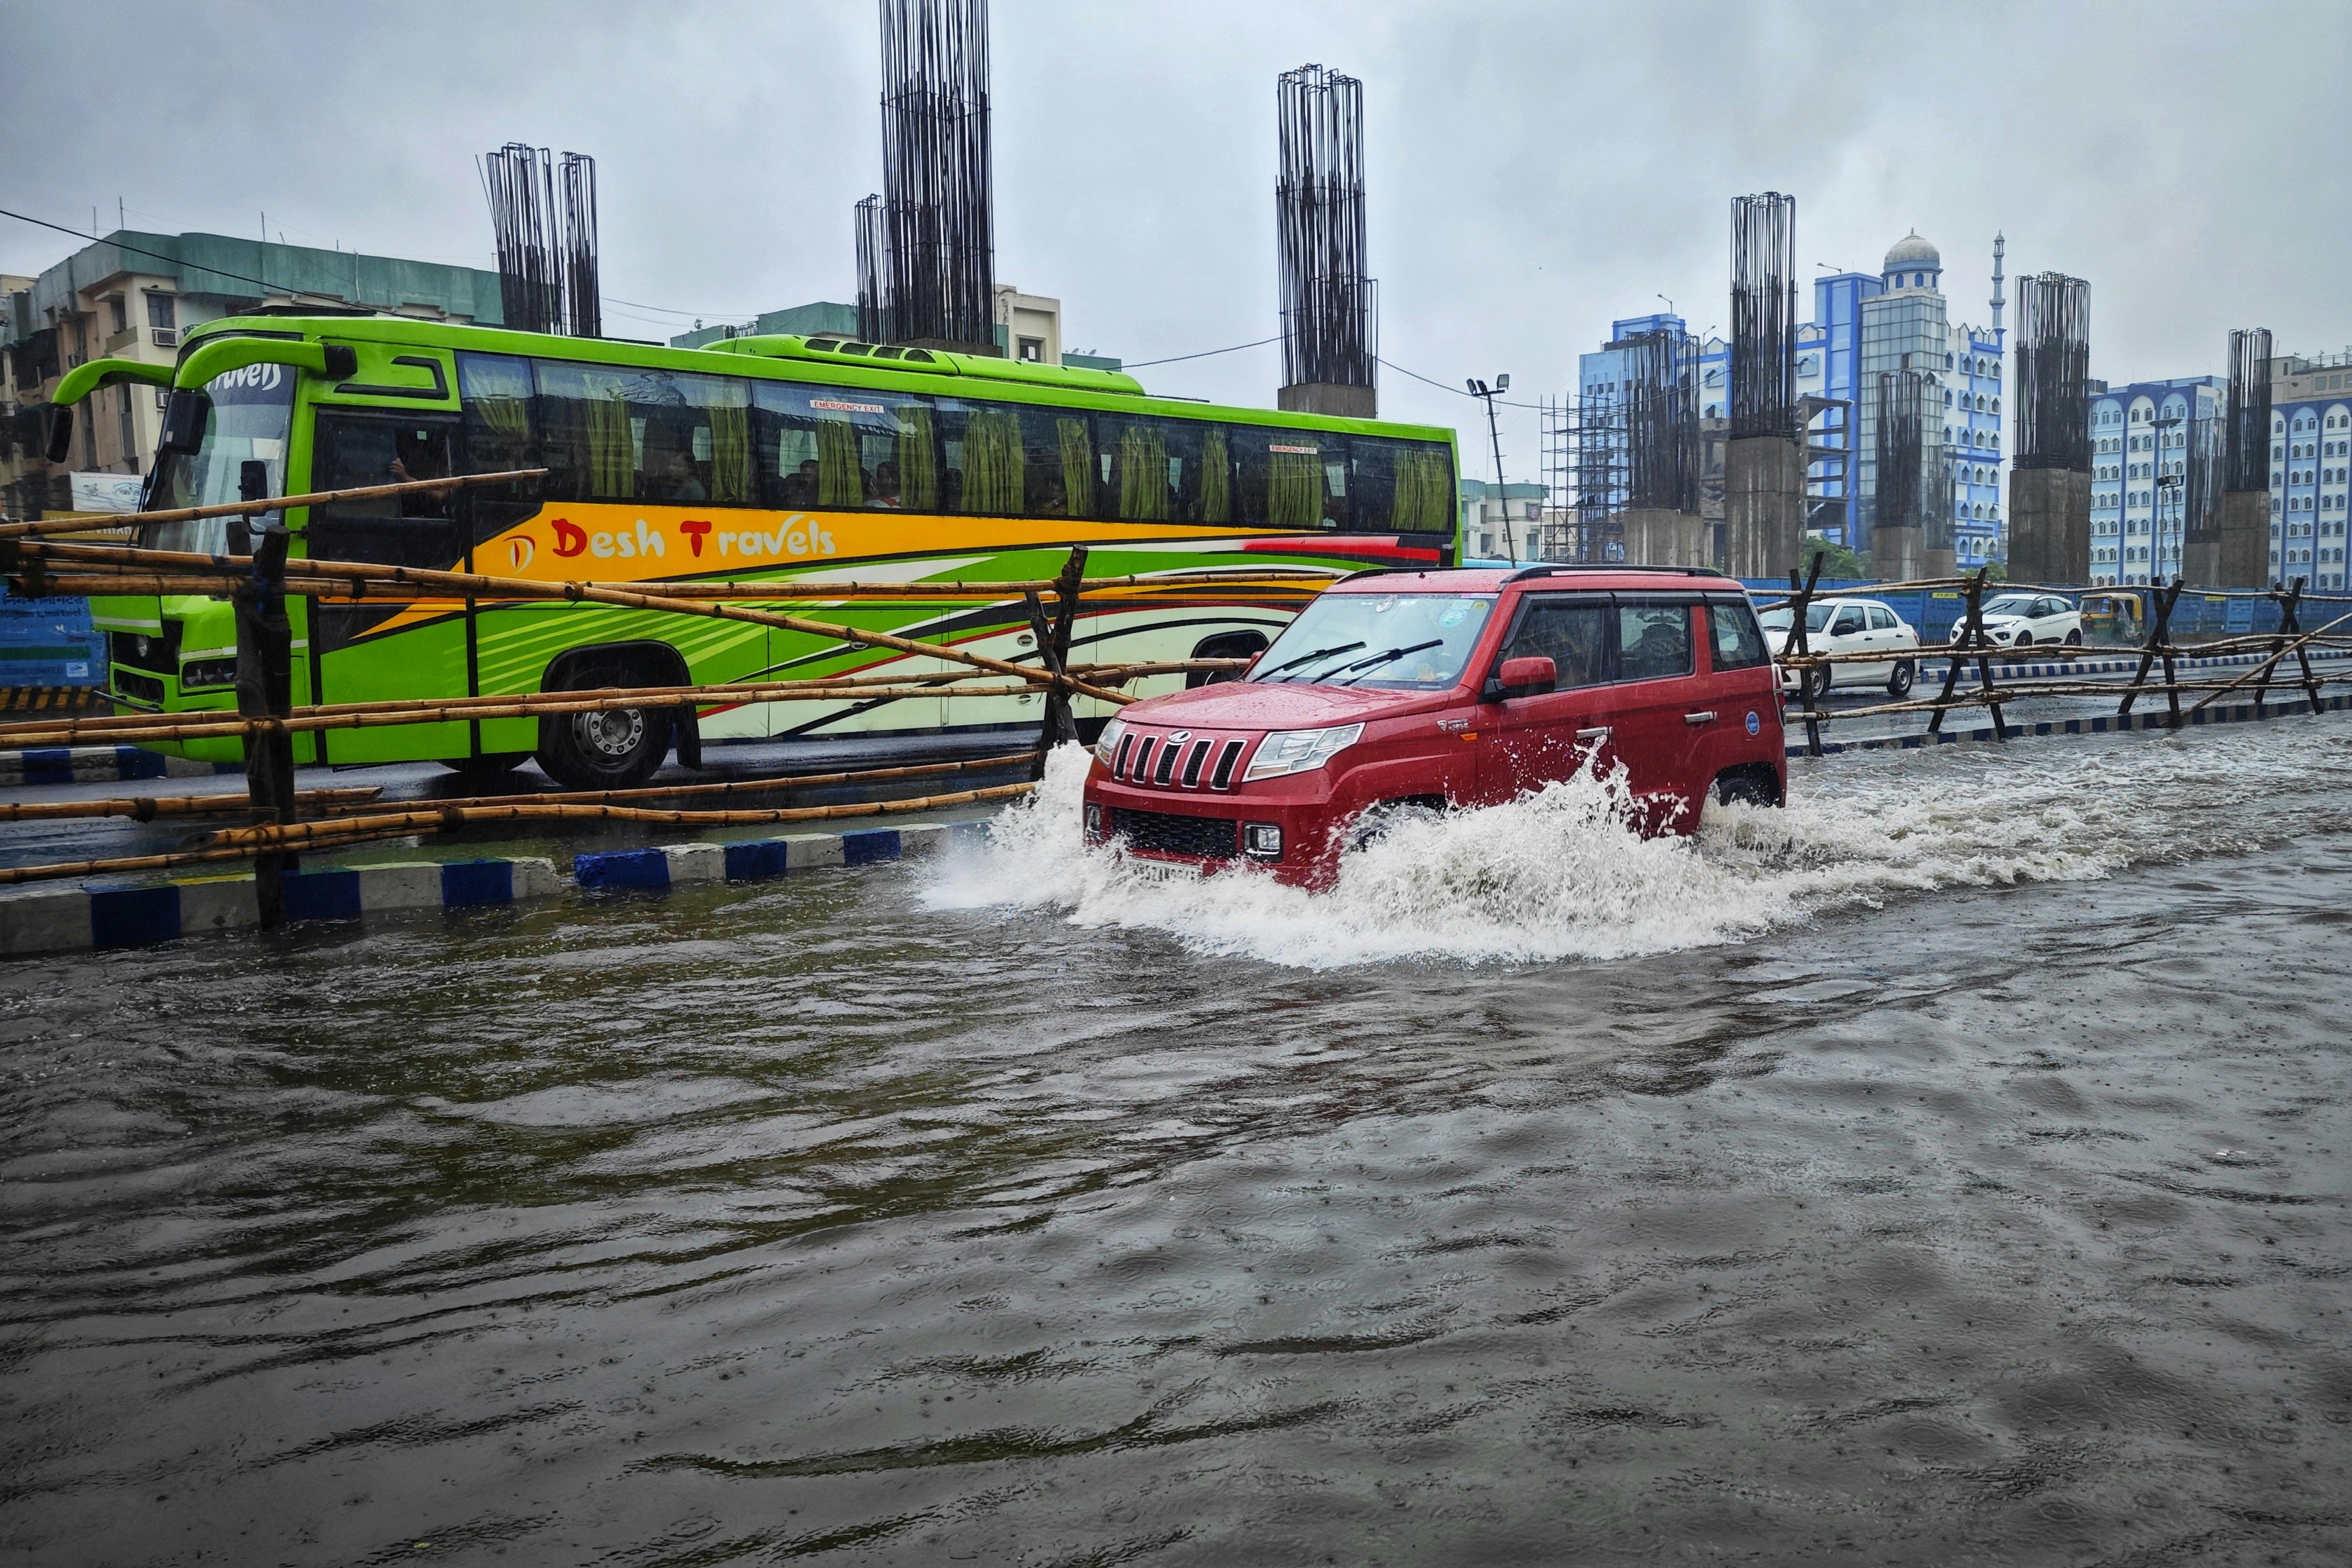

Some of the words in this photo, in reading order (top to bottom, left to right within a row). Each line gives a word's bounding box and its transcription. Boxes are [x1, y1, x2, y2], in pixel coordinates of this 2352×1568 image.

[814, 401, 862, 411] EMERGENCY
[551, 518, 665, 558] Desh
[679, 514, 836, 558] Travels
